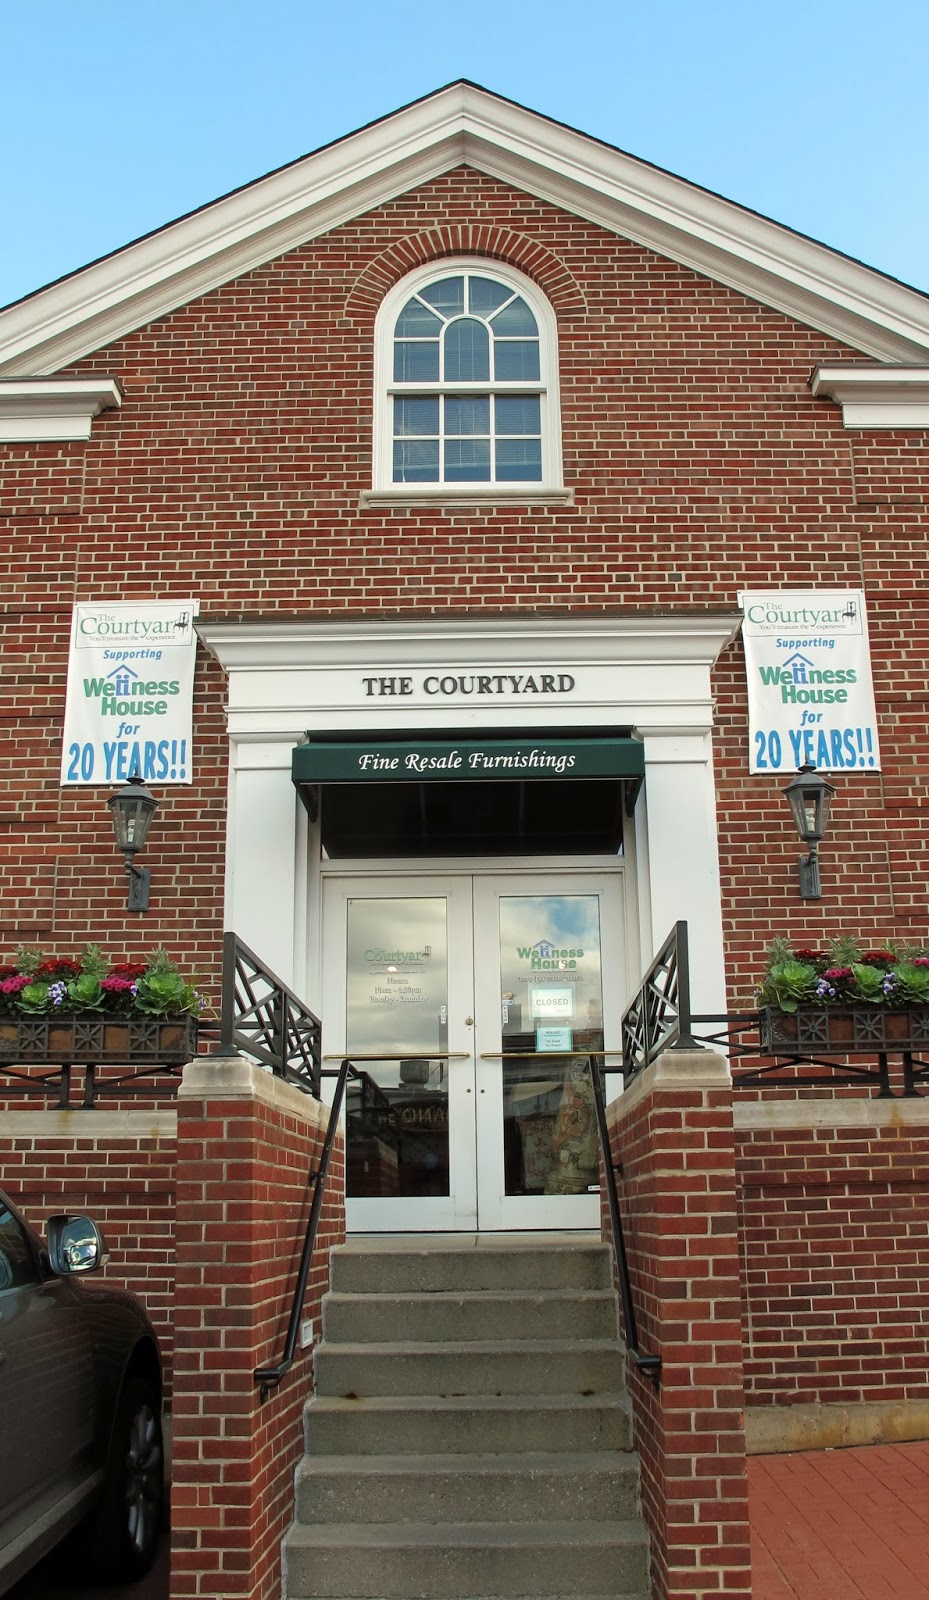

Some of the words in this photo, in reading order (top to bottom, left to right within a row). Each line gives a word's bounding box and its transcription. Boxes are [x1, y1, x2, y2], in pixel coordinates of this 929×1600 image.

[763, 602, 783, 610] The
[97, 613, 116, 621] The
[776, 638, 835, 649] Supporting
[103, 649, 162, 661] Supporting
[759, 663, 857, 685] Wellness
[83, 675, 180, 697] Wellness
[362, 677, 413, 696] THE
[423, 674, 575, 694] COURTYARD
[781, 685, 848, 704] House
[101, 697, 168, 716] House
[800, 710, 823, 726] for
[116, 722, 140, 738] for
[755, 730, 781, 768] 20
[788, 728, 875, 768] YEARS!!
[67, 742, 94, 781] 20
[103, 739, 187, 781] YEARS!!
[358, 754, 399, 770] Fine
[404, 751, 462, 772] Resale
[468, 750, 576, 772] Furnishings
[517, 946, 584, 959] Wellness
[531, 958, 577, 970] House
[536, 998, 569, 1006] CLOSED
